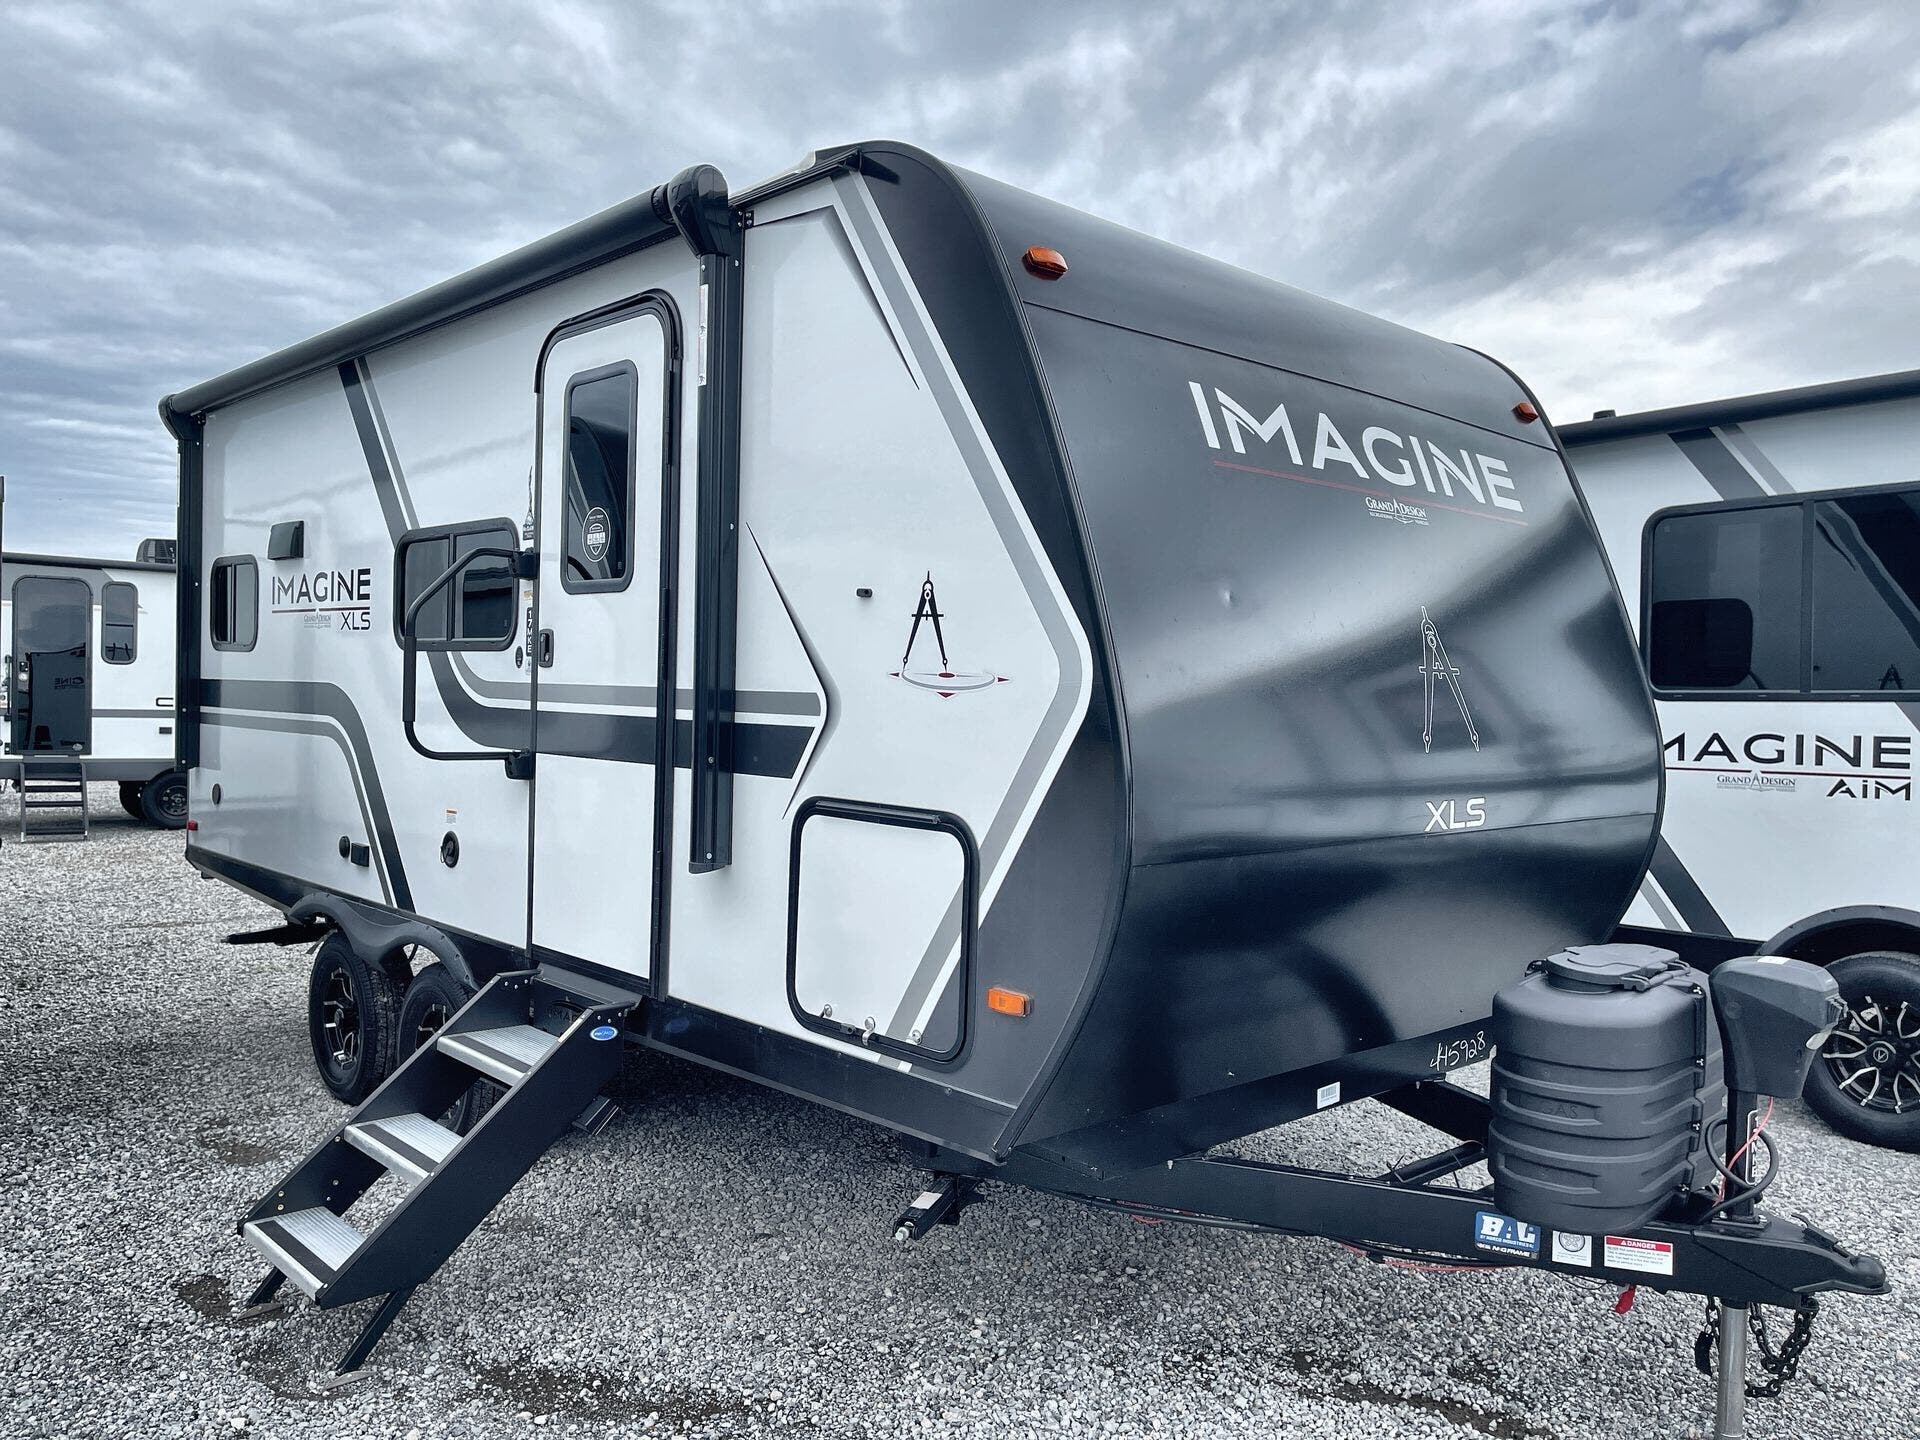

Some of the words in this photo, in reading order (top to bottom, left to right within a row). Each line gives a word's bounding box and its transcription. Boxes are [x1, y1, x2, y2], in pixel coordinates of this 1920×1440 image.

[1189, 381, 1523, 512] IMAGINE
[1365, 496, 1394, 512] GRAND
[272, 568, 371, 605] IMAGINE
[340, 611, 371, 631] XLS
[1663, 732, 1911, 770] AGINE
[1717, 774, 1751, 784] GRAND
[1761, 776, 1796, 786] DESIGN
[1424, 797, 1486, 832] XLS
[1626, 1240, 1657, 1250] DANGER
